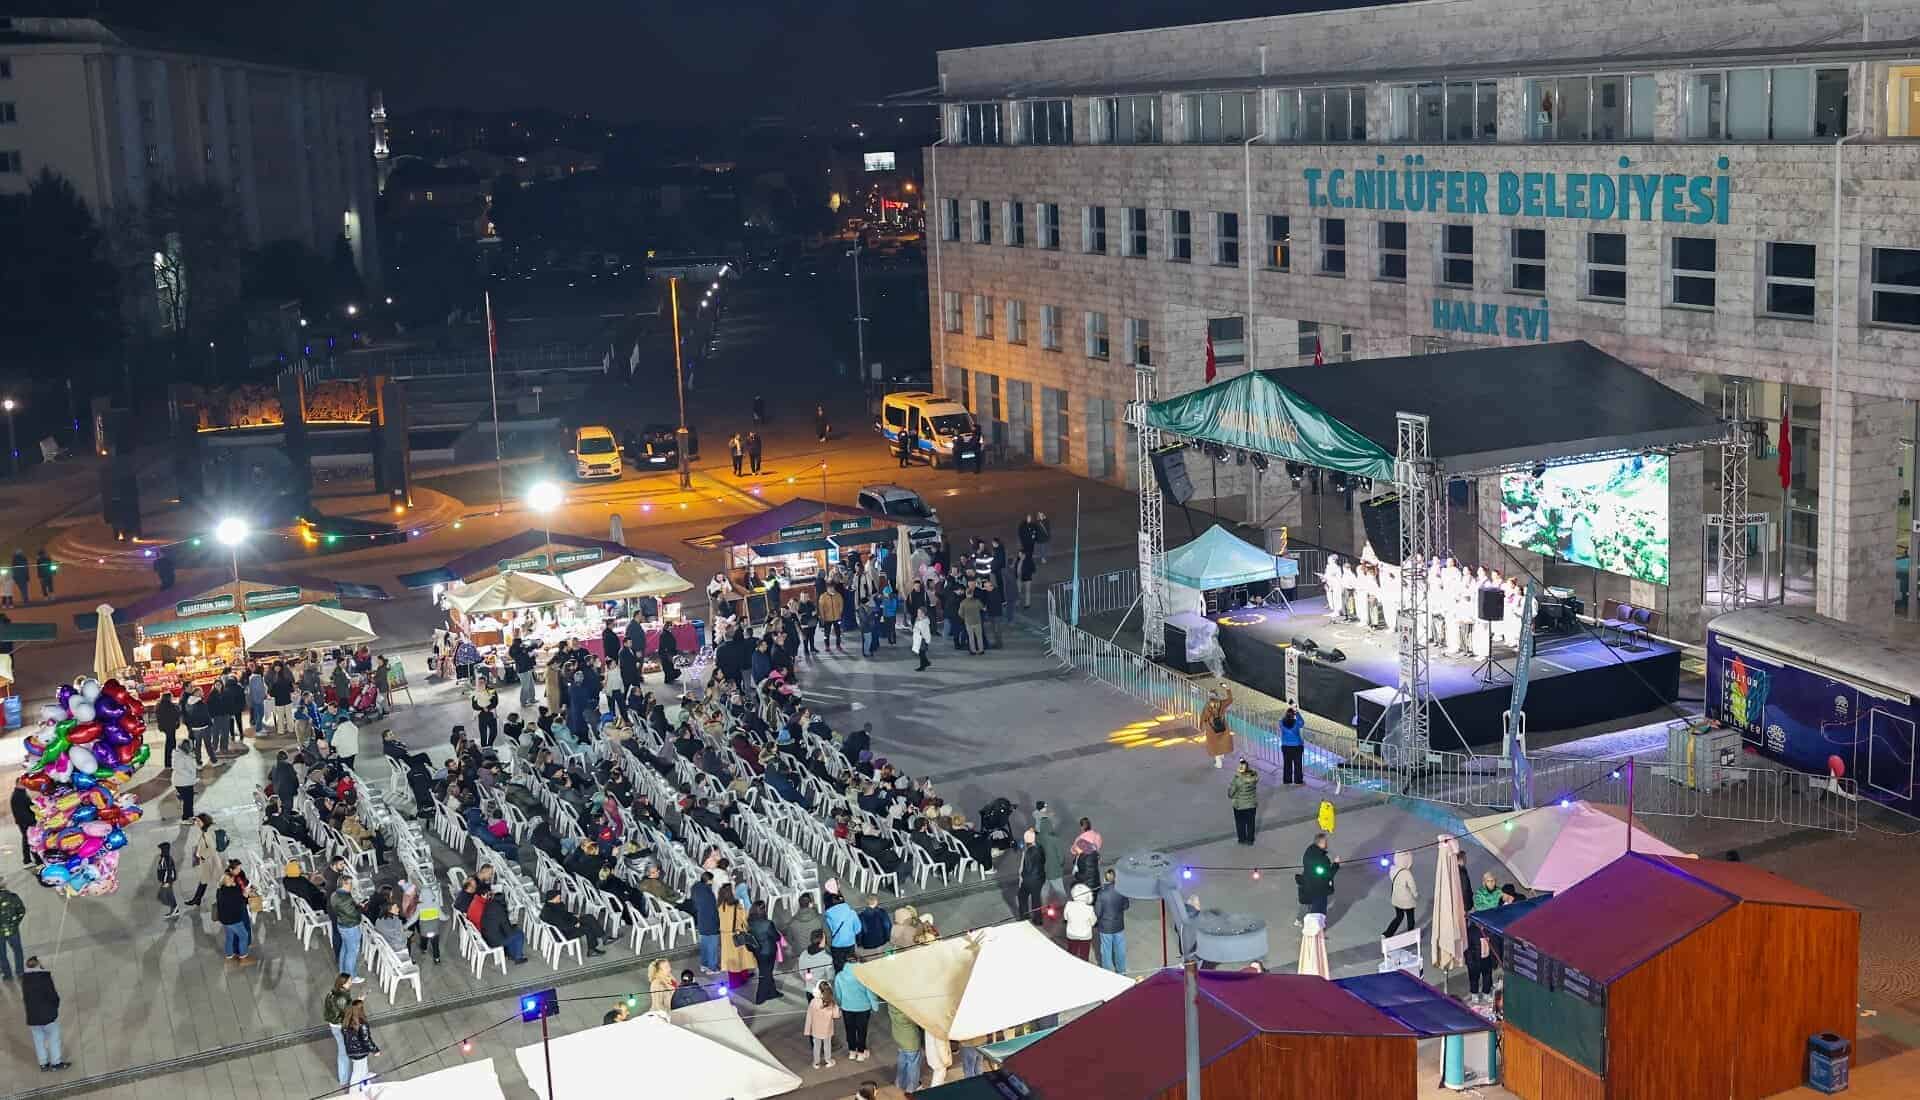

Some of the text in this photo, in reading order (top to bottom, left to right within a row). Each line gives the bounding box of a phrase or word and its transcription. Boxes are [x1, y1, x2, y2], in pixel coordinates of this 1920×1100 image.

[1498, 155, 1730, 225] BELEDİYESİ
[1433, 298, 1549, 342] HALK EVİ
